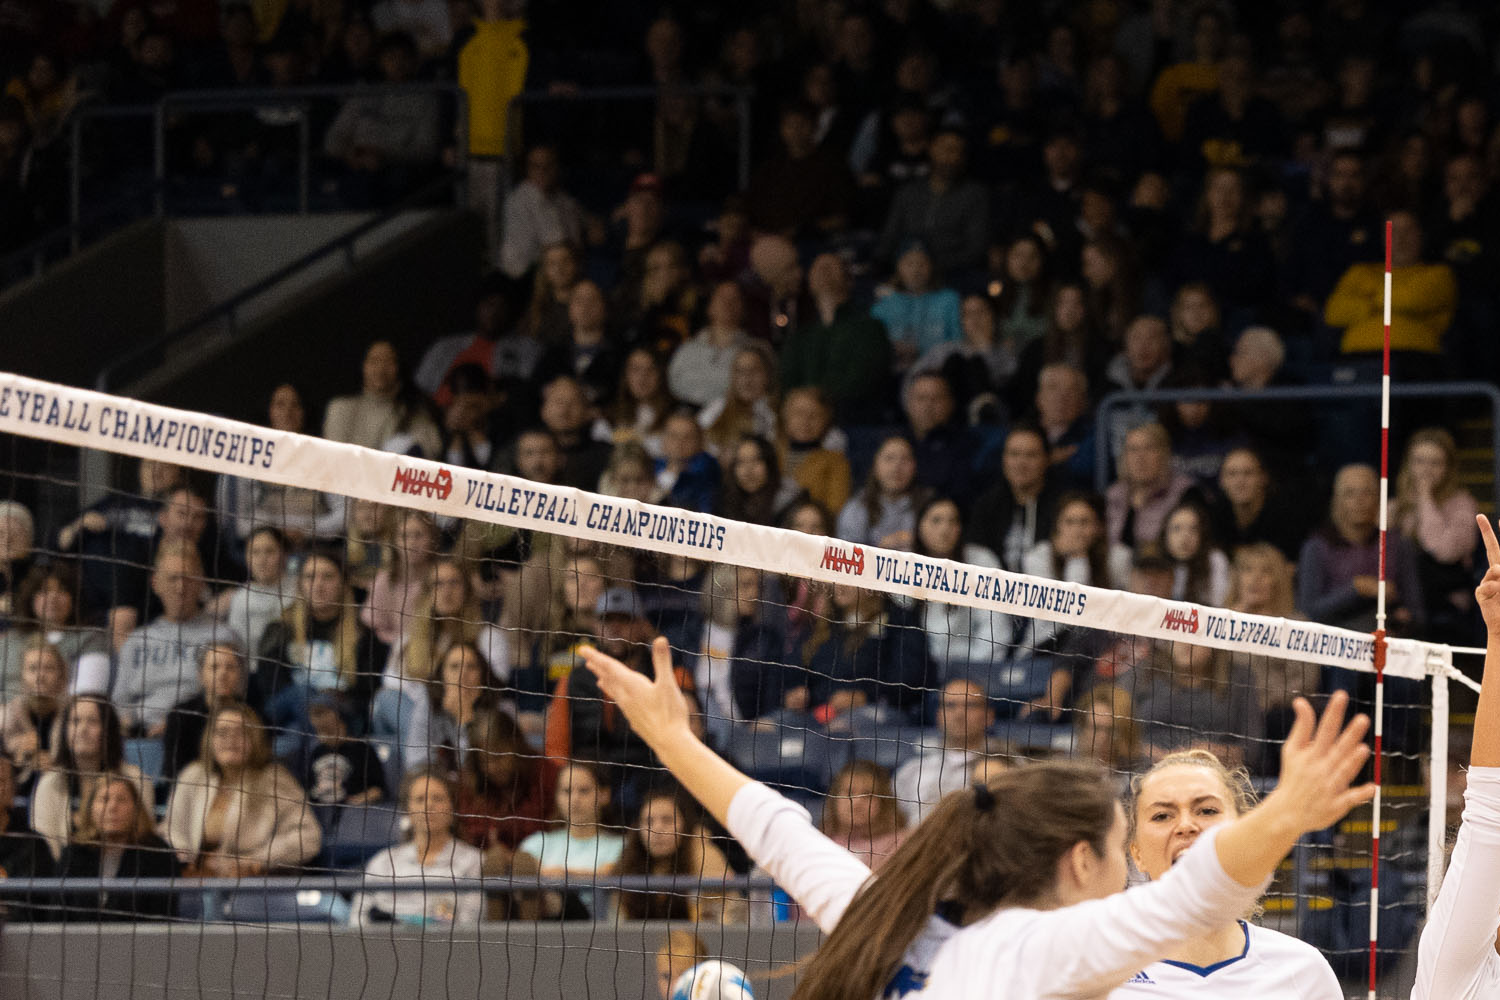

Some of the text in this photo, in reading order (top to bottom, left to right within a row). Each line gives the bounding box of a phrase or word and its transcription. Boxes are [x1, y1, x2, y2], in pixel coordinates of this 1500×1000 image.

[98, 406, 276, 469] CHAMPIONSHIPS
[465, 479, 578, 526] VOLLEYBALL
[586, 503, 727, 551] CHAMPIONSHIPS
[876, 555, 970, 596] VOLLEYBALL
[974, 574, 1087, 616] CHAMPIONSHIPS
[1205, 615, 1281, 649] VOLLEYBALL
[1286, 629, 1377, 664] CHAMPIONSHIPS
